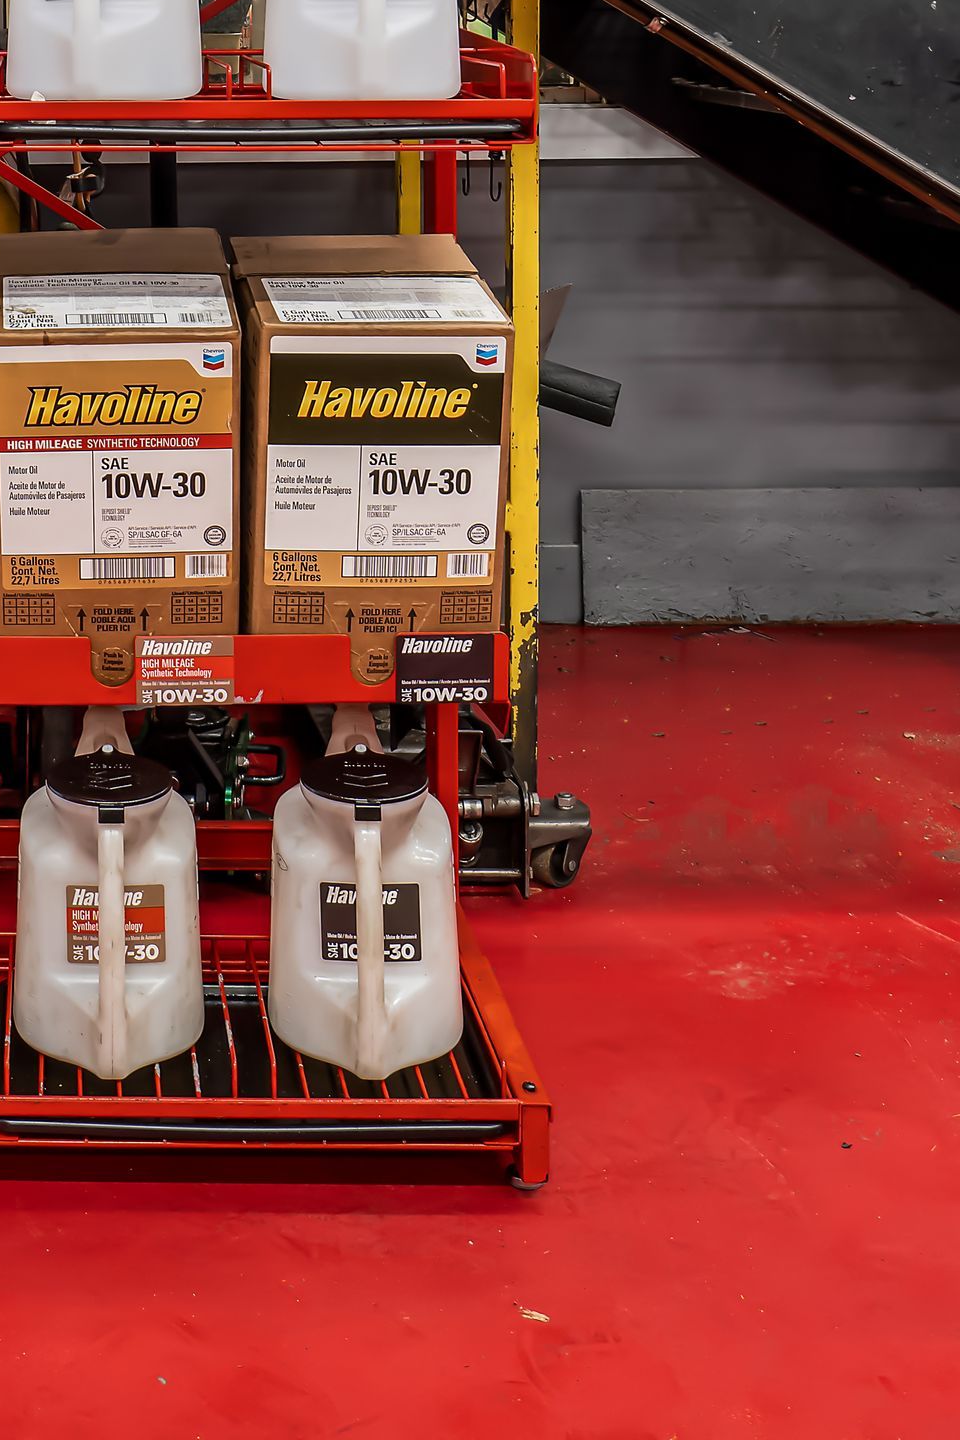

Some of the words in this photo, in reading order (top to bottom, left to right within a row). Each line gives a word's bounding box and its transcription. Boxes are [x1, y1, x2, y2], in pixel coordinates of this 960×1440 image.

[24, 384, 203, 428] Havoline
[297, 380, 472, 419] Havoline
[7, 440, 33, 449] HIGH
[35, 439, 82, 449] MILEAGE
[86, 438, 138, 448] SYNTHETIC
[140, 437, 200, 447] TECHNOLOGY
[101, 457, 129, 470] SAE
[369, 452, 397, 466] SAE
[101, 472, 206, 499] 10W-30
[368, 469, 472, 495] 10W-30
[273, 552, 279, 562] 6
[281, 553, 317, 563] Gallons
[273, 562, 298, 572] Cont.
[300, 562, 320, 572] Net.
[272, 572, 292, 583] 22,7
[294, 572, 321, 582] Litres
[141, 640, 213, 656] Havoline
[401, 638, 473, 654] Havoline
[141, 658, 160, 668] HIGH
[162, 658, 195, 668] MILEAGE
[141, 668, 173, 678] Synthetic
[175, 668, 212, 679] Technology
[142, 689, 152, 704] SAE
[154, 688, 228, 703] 10W-30
[401, 688, 412, 702] SAE
[413, 687, 487, 702] 10W-30
[72, 910, 90, 920] HIGH
[327, 942, 339, 959] SAE
